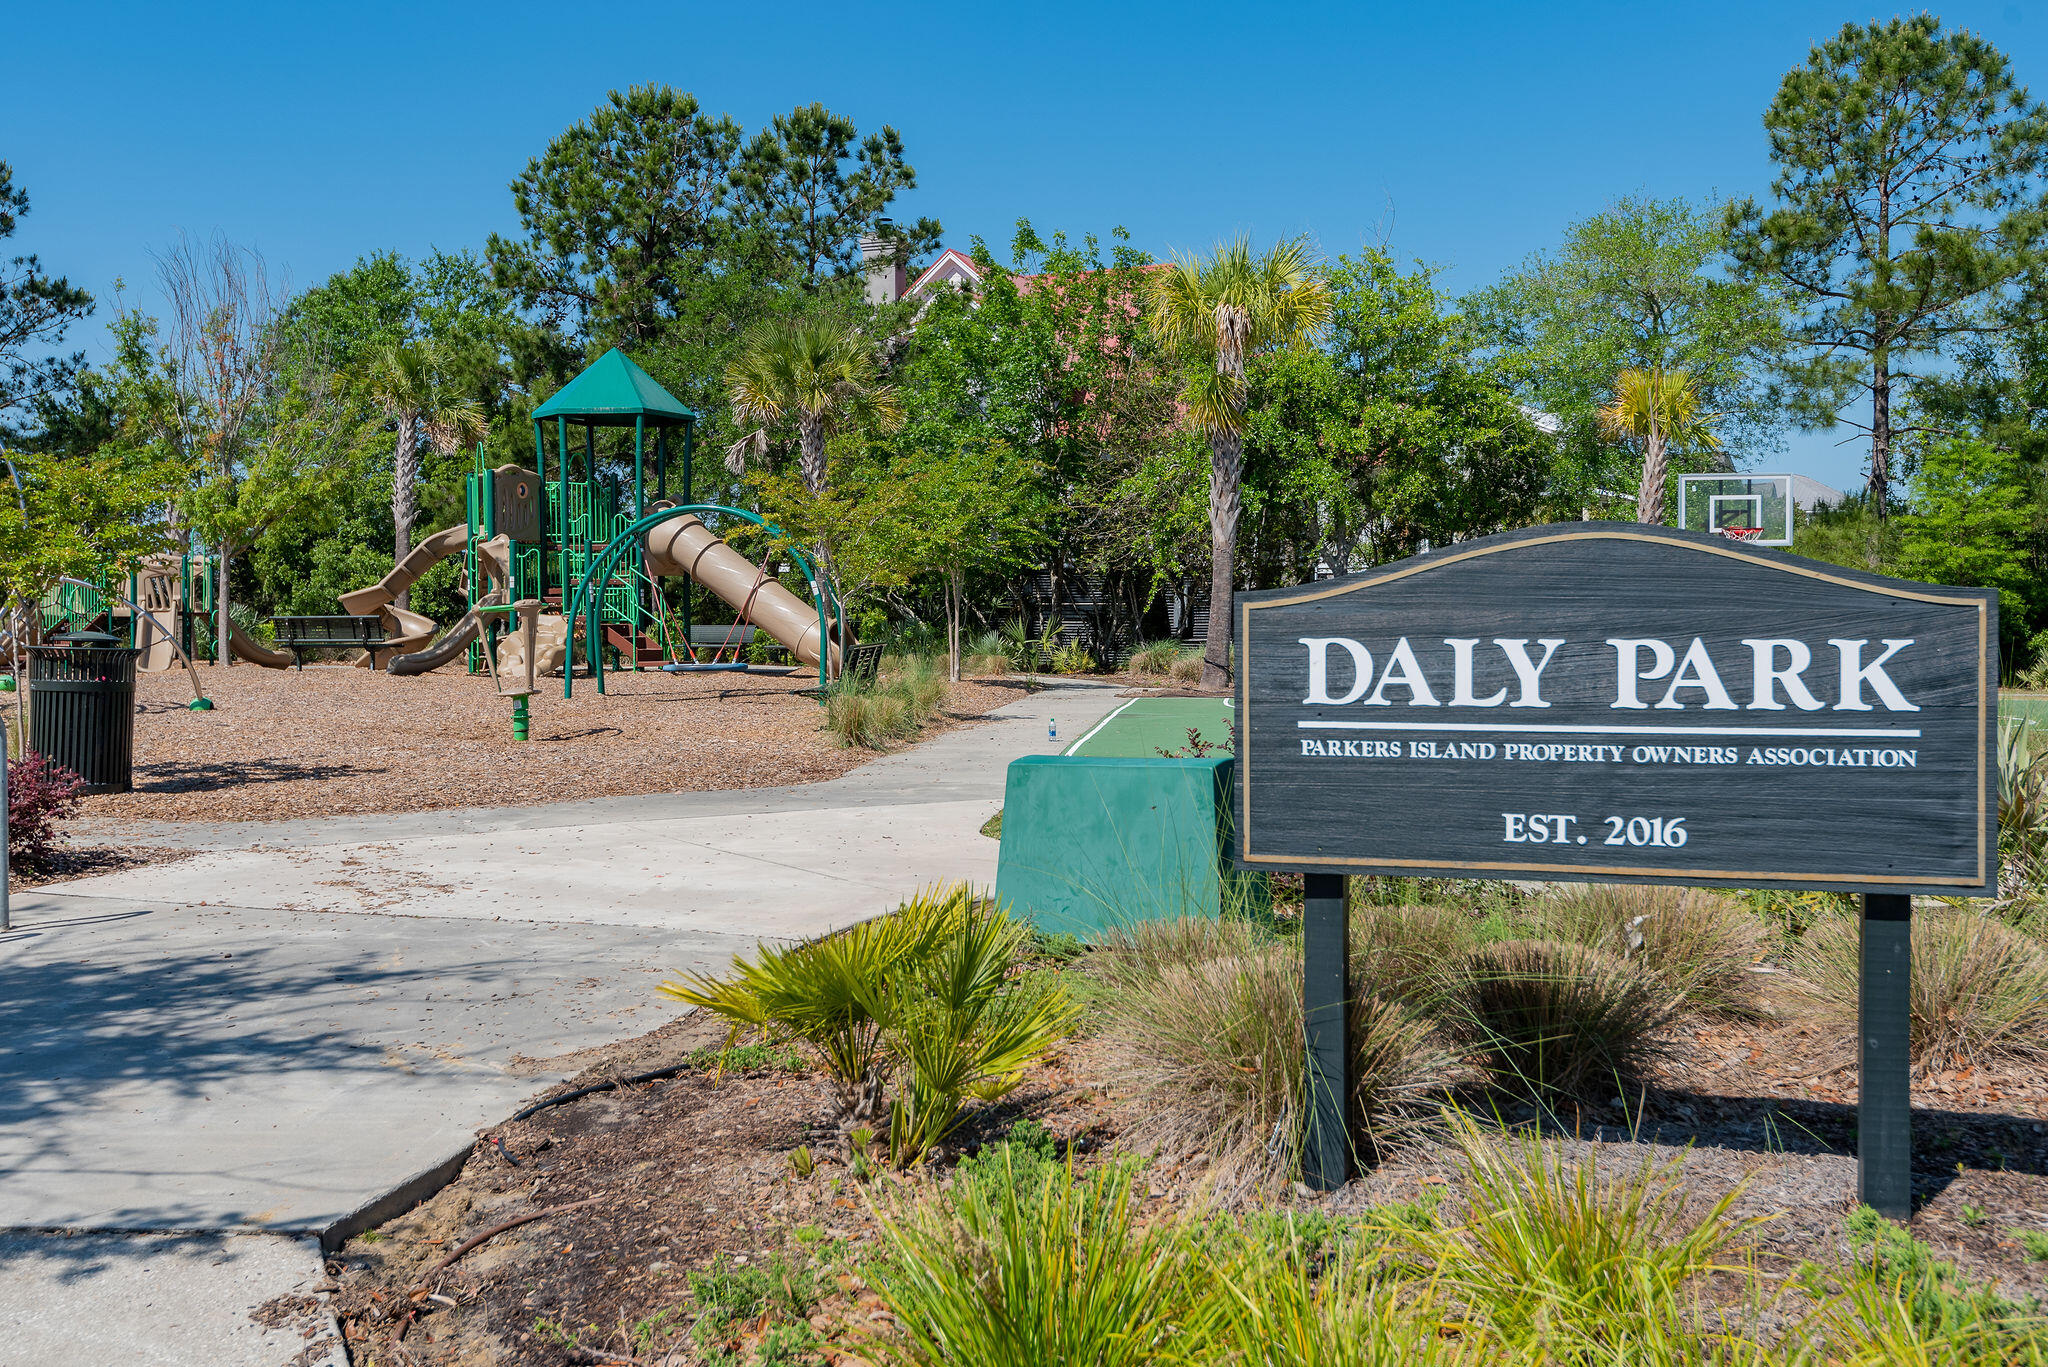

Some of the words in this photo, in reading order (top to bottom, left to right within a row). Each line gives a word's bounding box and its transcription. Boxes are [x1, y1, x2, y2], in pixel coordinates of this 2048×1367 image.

[1298, 636, 1566, 709] DALY
[1605, 637, 1921, 713] PARK
[1300, 739, 1402, 759] PARKERS
[1408, 741, 1496, 761] ISLAND
[1502, 743, 1625, 763] PROPERTY
[1632, 745, 1738, 765] OWNERS
[1745, 747, 1918, 768] ASSOCIATION
[1502, 813, 1587, 845] EST.
[1603, 815, 1688, 848] 2016
